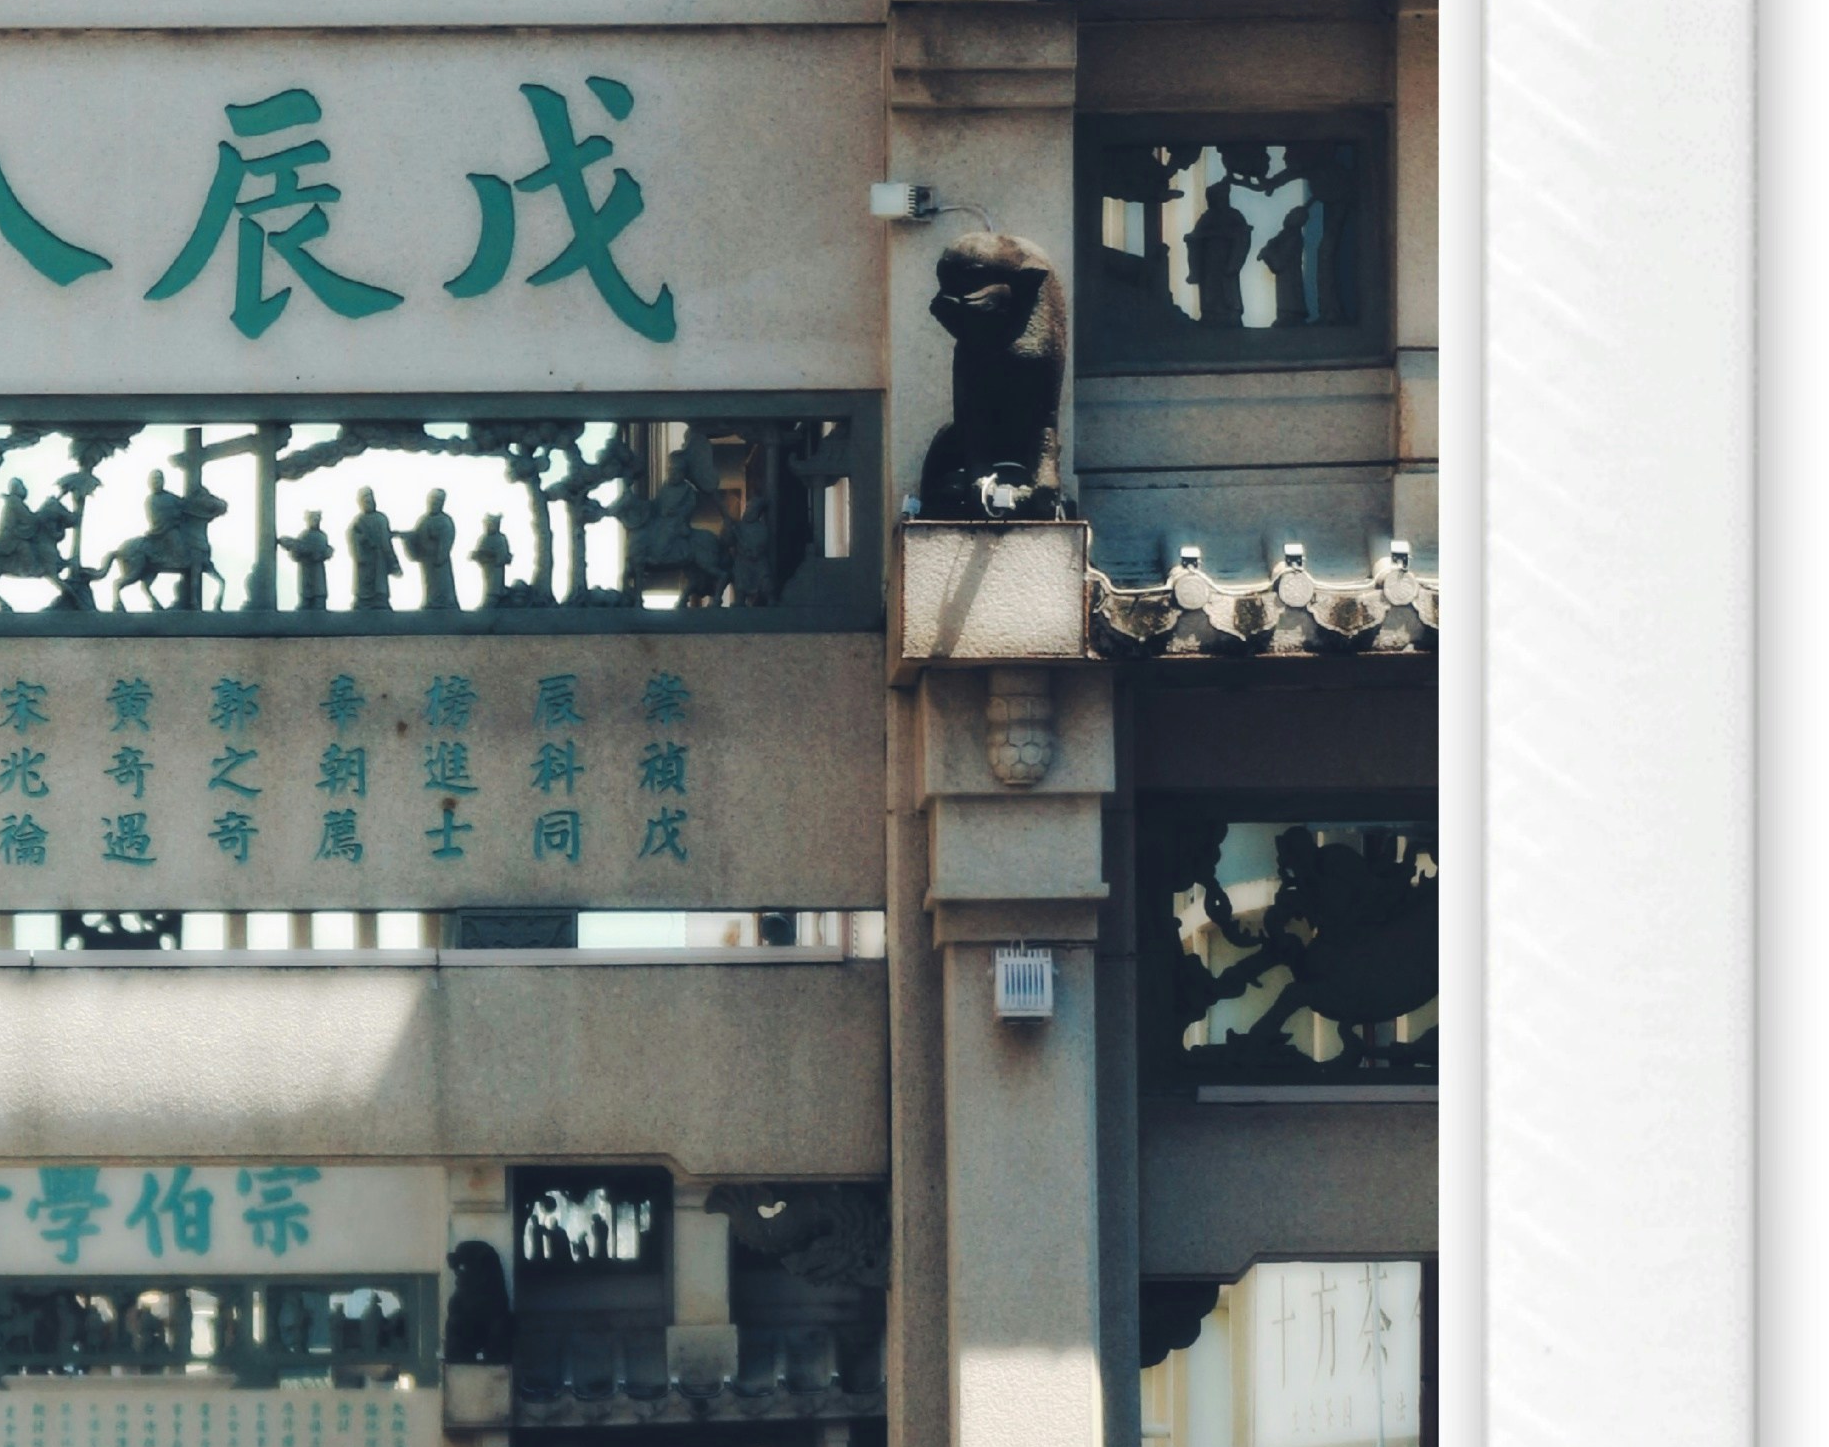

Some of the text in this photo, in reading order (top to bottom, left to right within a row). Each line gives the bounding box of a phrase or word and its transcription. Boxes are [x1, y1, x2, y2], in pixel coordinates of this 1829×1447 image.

[207, 676, 263, 865] 郭之奇
[424, 672, 479, 862] 榜進士
[531, 673, 586, 865] 辰科同
[1271, 1264, 1419, 1389] 十方茶
